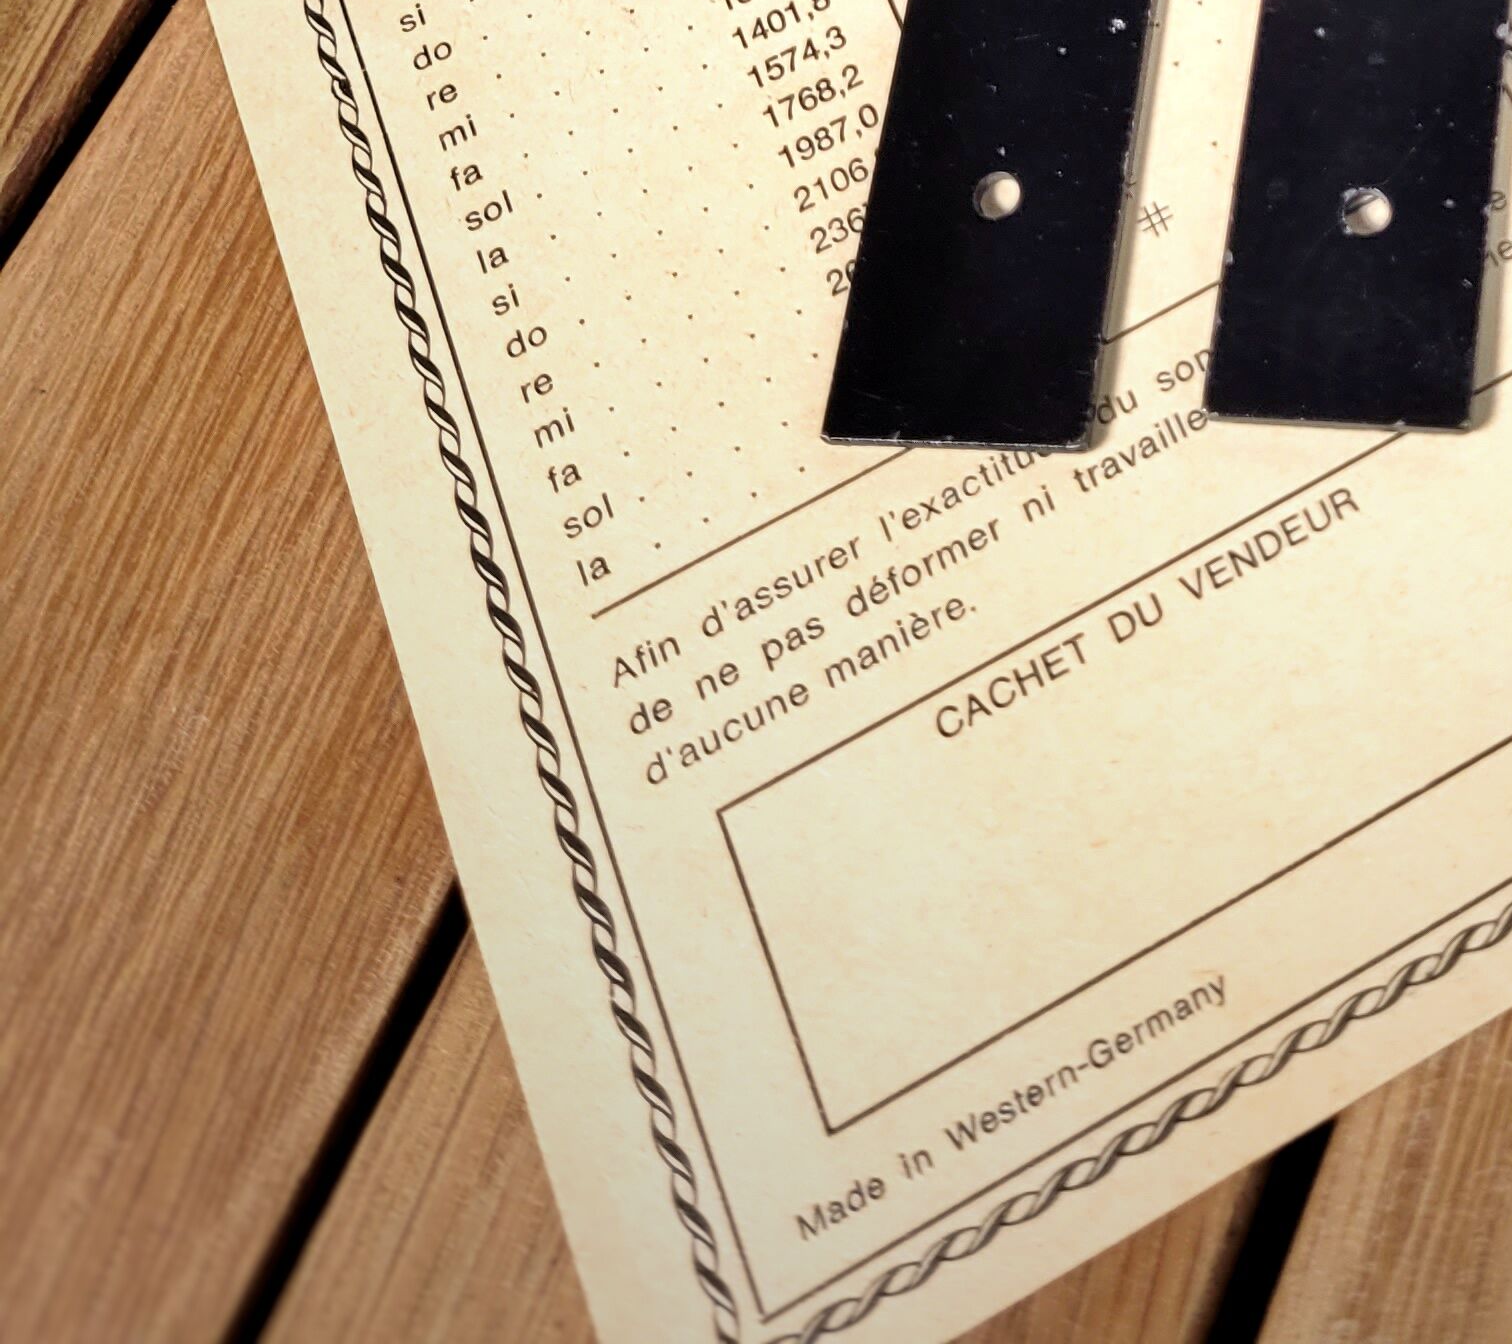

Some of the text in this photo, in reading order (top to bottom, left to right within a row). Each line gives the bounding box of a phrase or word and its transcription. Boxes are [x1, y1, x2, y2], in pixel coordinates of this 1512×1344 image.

[399, 2, 427, 33] si
[412, 41, 453, 71] do
[426, 83, 459, 112] re
[438, 113, 478, 152] mi
[464, 25, 847, 232] sol 1574,3
[449, 163, 484, 192] fa
[476, 63, 864, 275] la 1768,2
[491, 103, 879, 317] si 1987,0
[506, 325, 548, 359] do
[520, 373, 554, 404] re
[533, 406, 575, 449] mi
[547, 463, 583, 494] fa
[563, 492, 614, 539] sol
[613, 636, 681, 689] Afin
[701, 536, 860, 638] d'assurer
[878, 443, 1052, 543] l'exactitu
[1097, 390, 1139, 425] du
[576, 556, 612, 587] la
[629, 407, 1211, 735] de ne pas déformer ni travaille
[935, 487, 1360, 739] CACHET DU VENDEUR
[646, 598, 977, 785] d'aucune manière.
[796, 975, 1225, 1240] Made in Western-Germany
